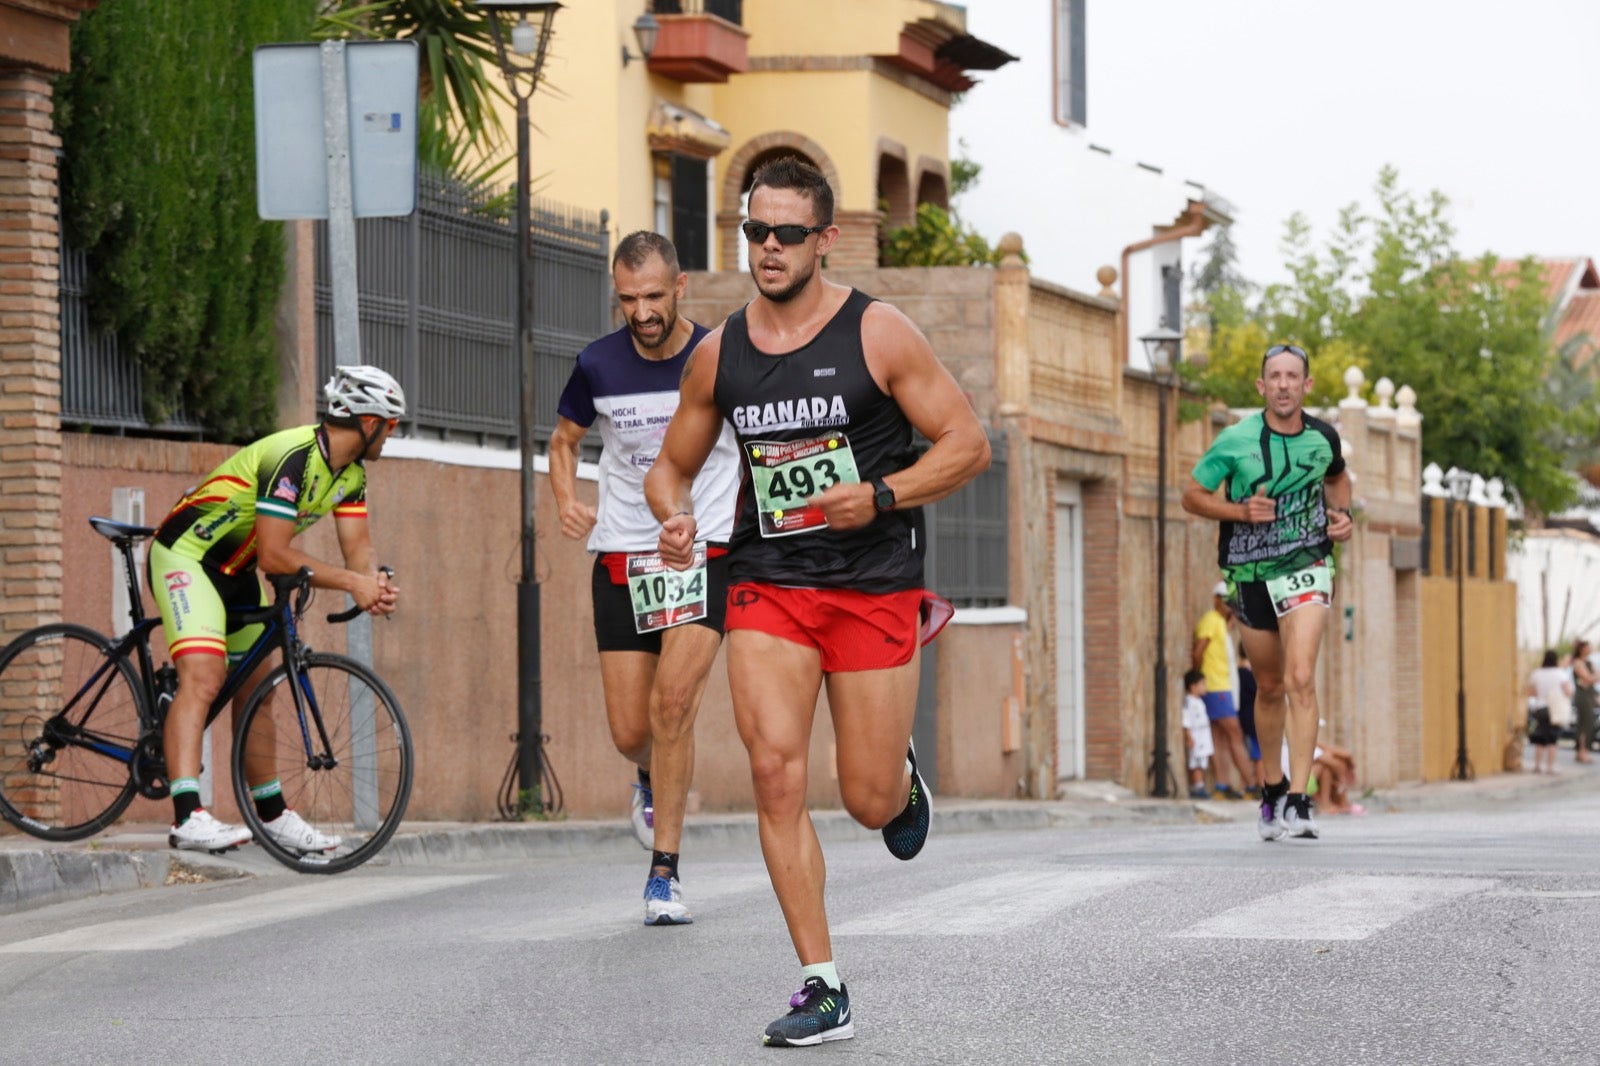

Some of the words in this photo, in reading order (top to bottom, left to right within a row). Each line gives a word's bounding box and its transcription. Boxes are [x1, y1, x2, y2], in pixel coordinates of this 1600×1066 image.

[612, 407, 636, 417] NOCHE
[624, 419, 644, 428] TRAIL
[733, 395, 847, 428] GRANADA
[768, 459, 840, 501] 493
[636, 571, 704, 607] 1034
[1286, 572, 1315, 591] 39
